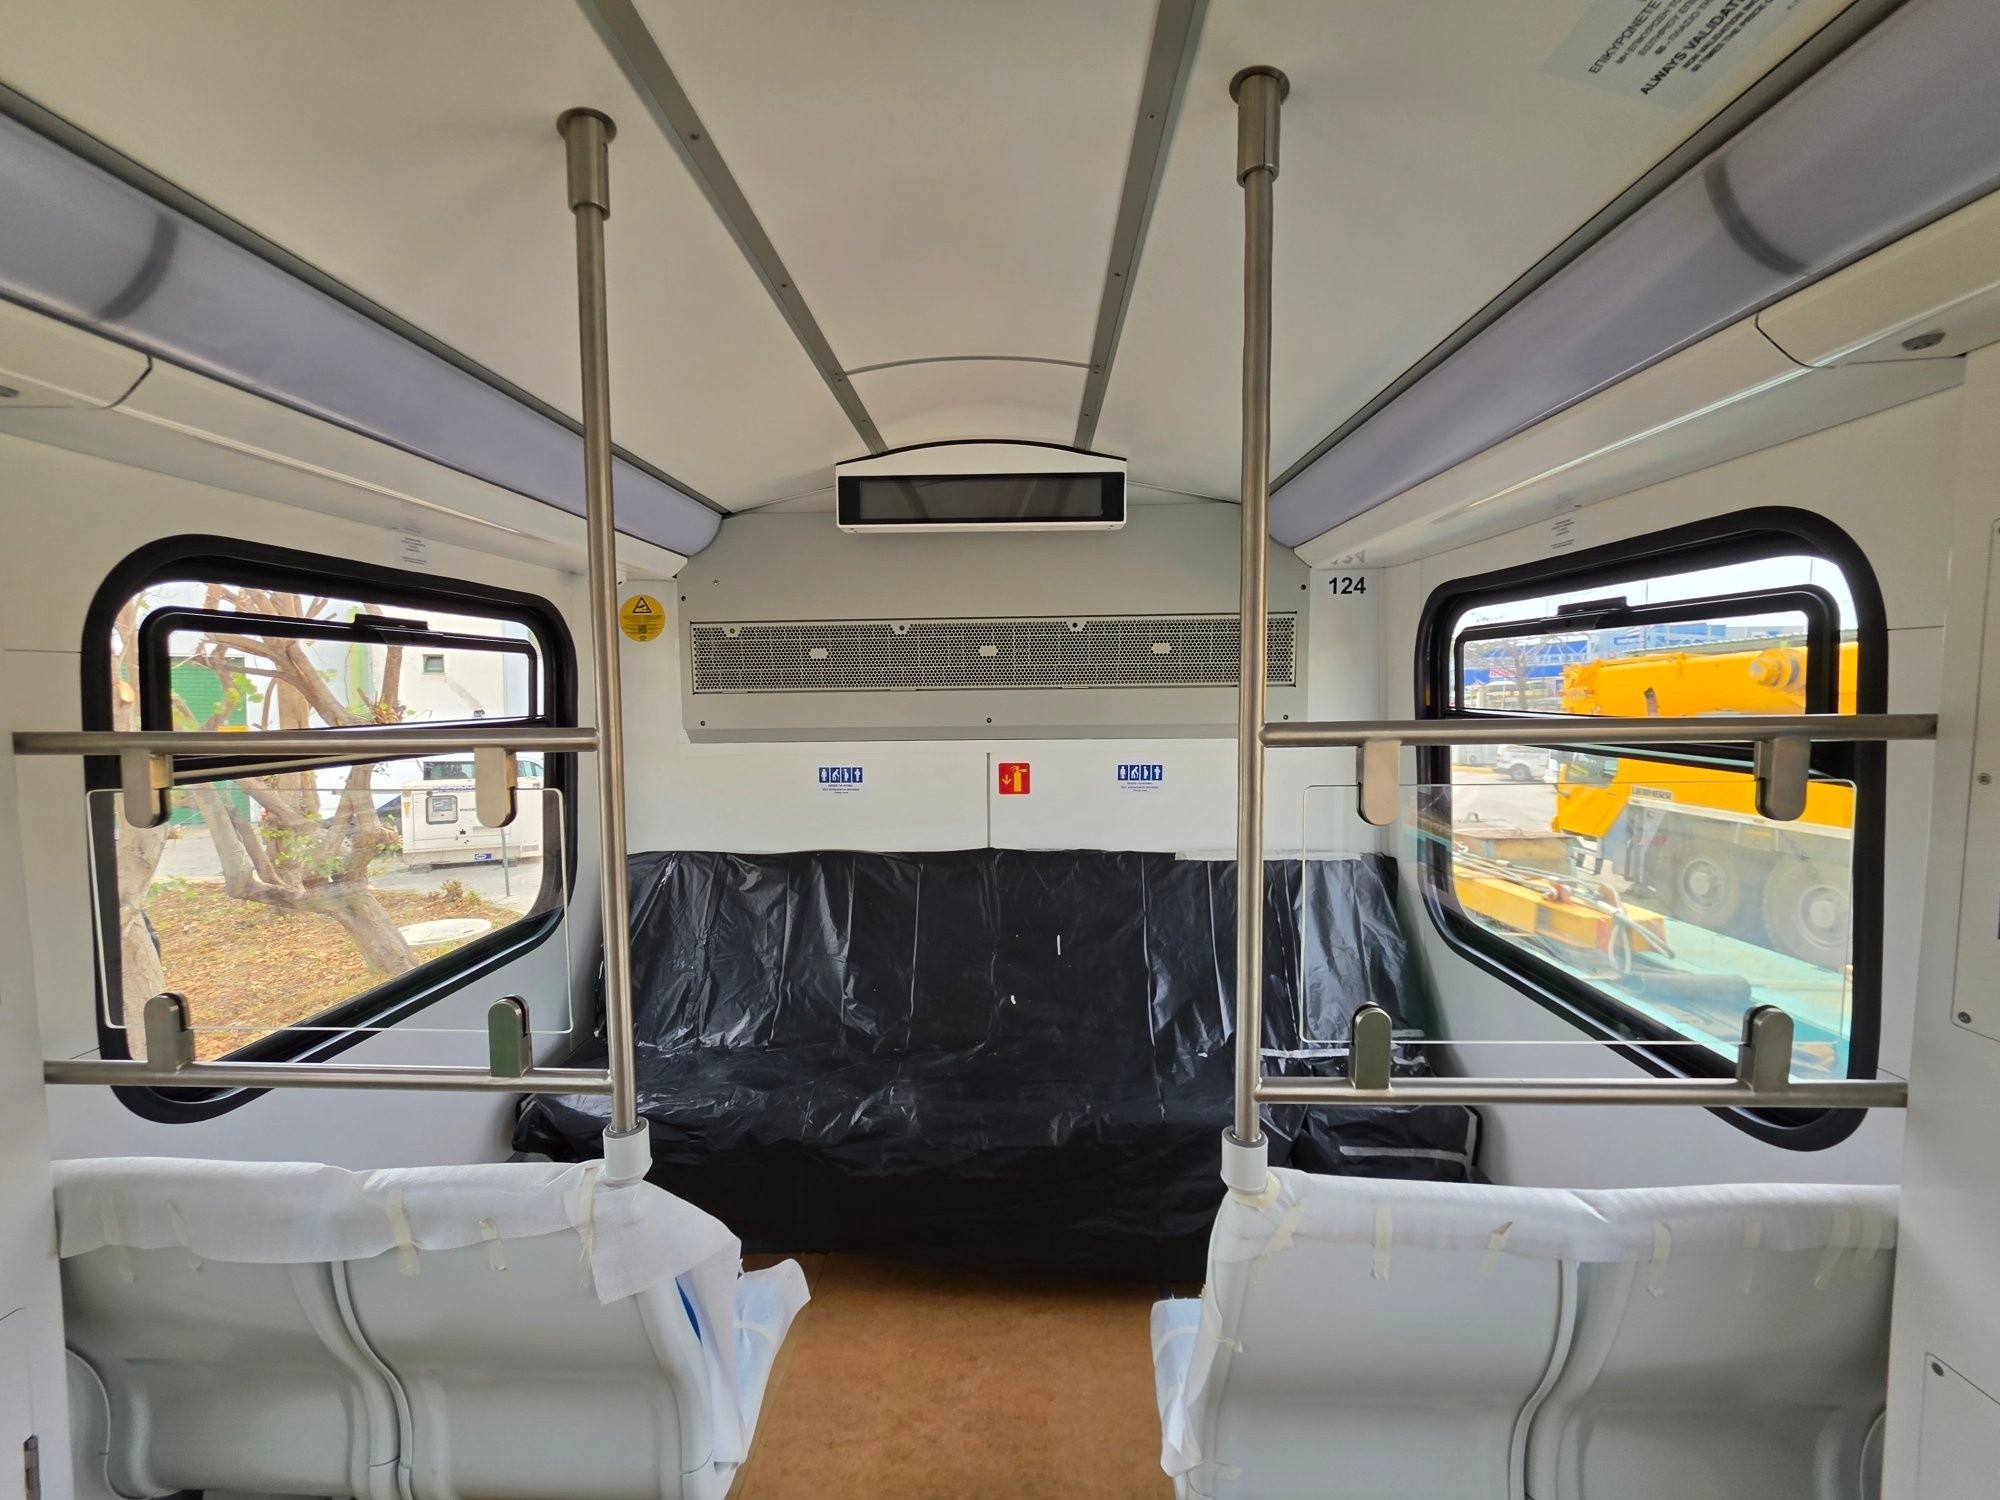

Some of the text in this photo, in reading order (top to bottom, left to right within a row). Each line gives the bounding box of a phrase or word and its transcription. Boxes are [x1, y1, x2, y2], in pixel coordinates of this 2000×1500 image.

[1640, 0, 1746, 95] ALWAYS VALIDAT
[1329, 577, 1366, 594] 124
